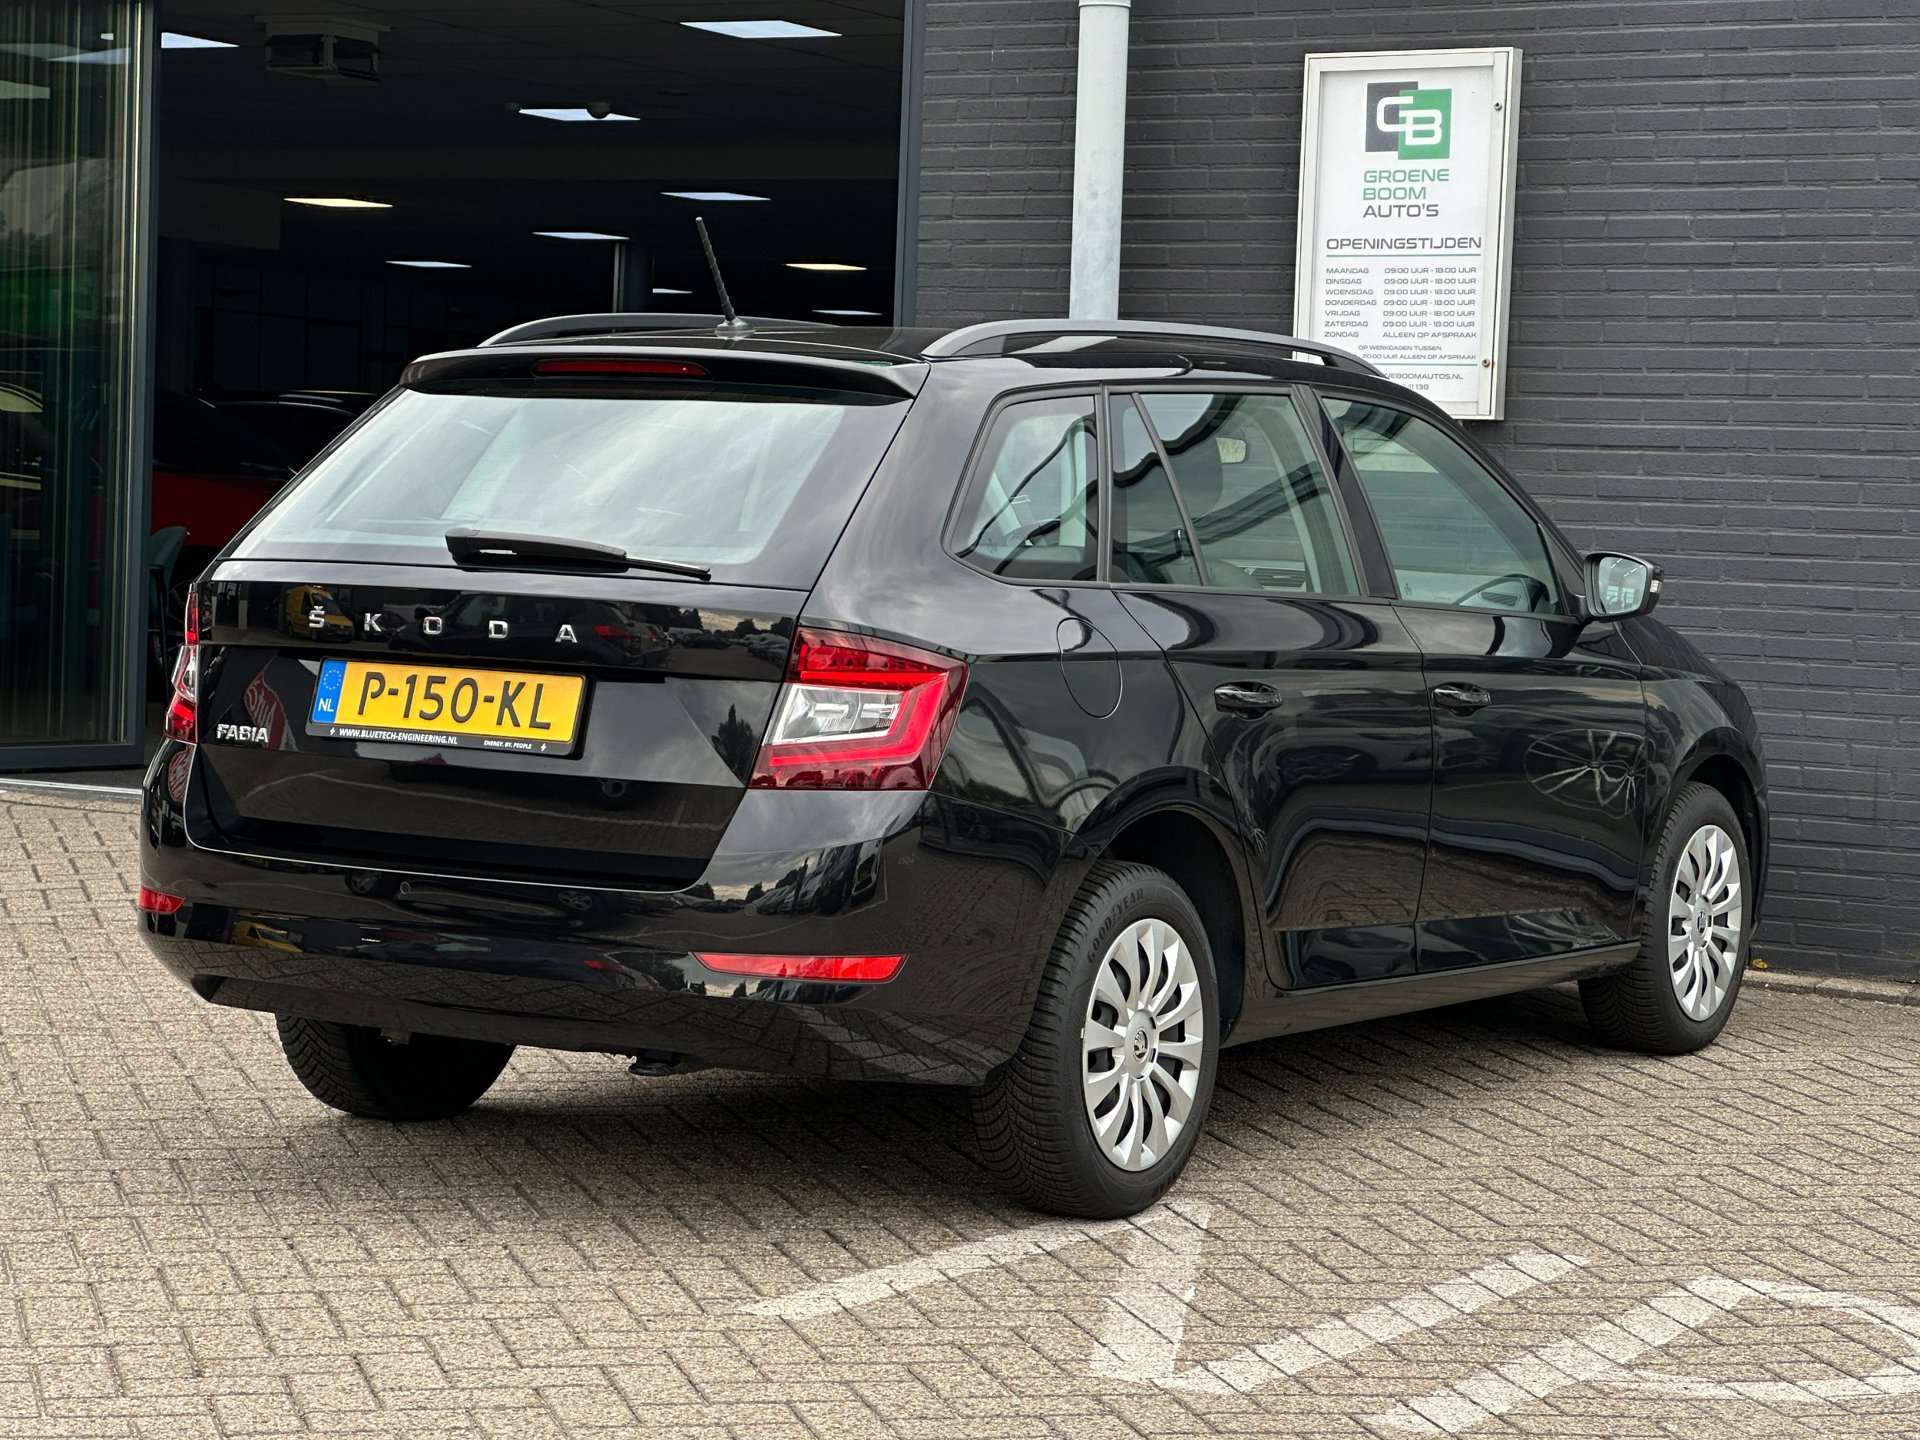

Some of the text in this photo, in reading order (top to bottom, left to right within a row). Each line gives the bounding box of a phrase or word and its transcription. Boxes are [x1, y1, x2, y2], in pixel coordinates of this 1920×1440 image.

[1363, 169, 1450, 183] GROENE
[1362, 187, 1426, 201] BOOM
[1362, 204, 1439, 218] AUTO'S
[1326, 237, 1482, 250] OPENINGSTIJDEN
[317, 698, 335, 713] NL
[356, 670, 552, 729] P-150-KL
[215, 723, 269, 743] FABIA
[339, 728, 459, 745] WWW.BLUETECH-ENGINEERING.NL
[513, 742, 532, 750] PEOPLE
